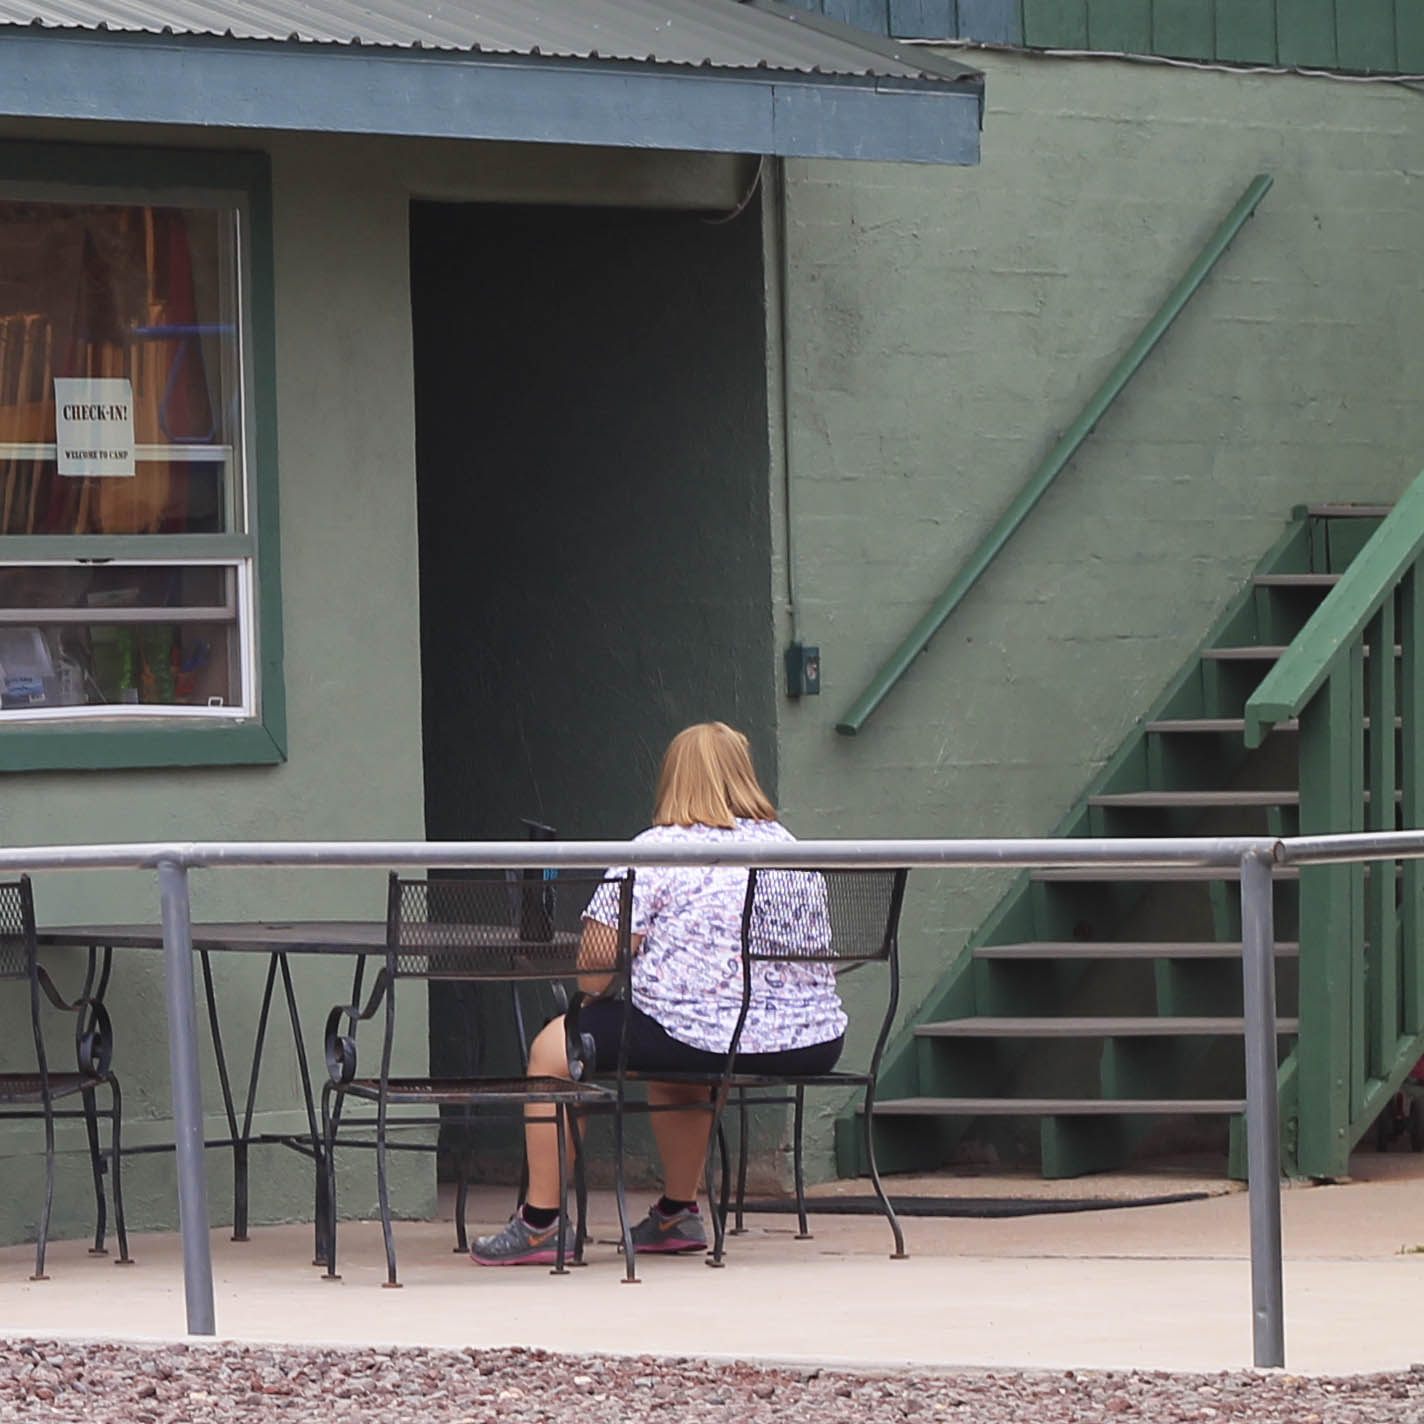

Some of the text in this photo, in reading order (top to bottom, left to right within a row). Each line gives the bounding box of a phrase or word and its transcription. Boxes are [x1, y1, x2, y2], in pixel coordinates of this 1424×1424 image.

[65, 450, 129, 460] WELCOME TO CAMP
